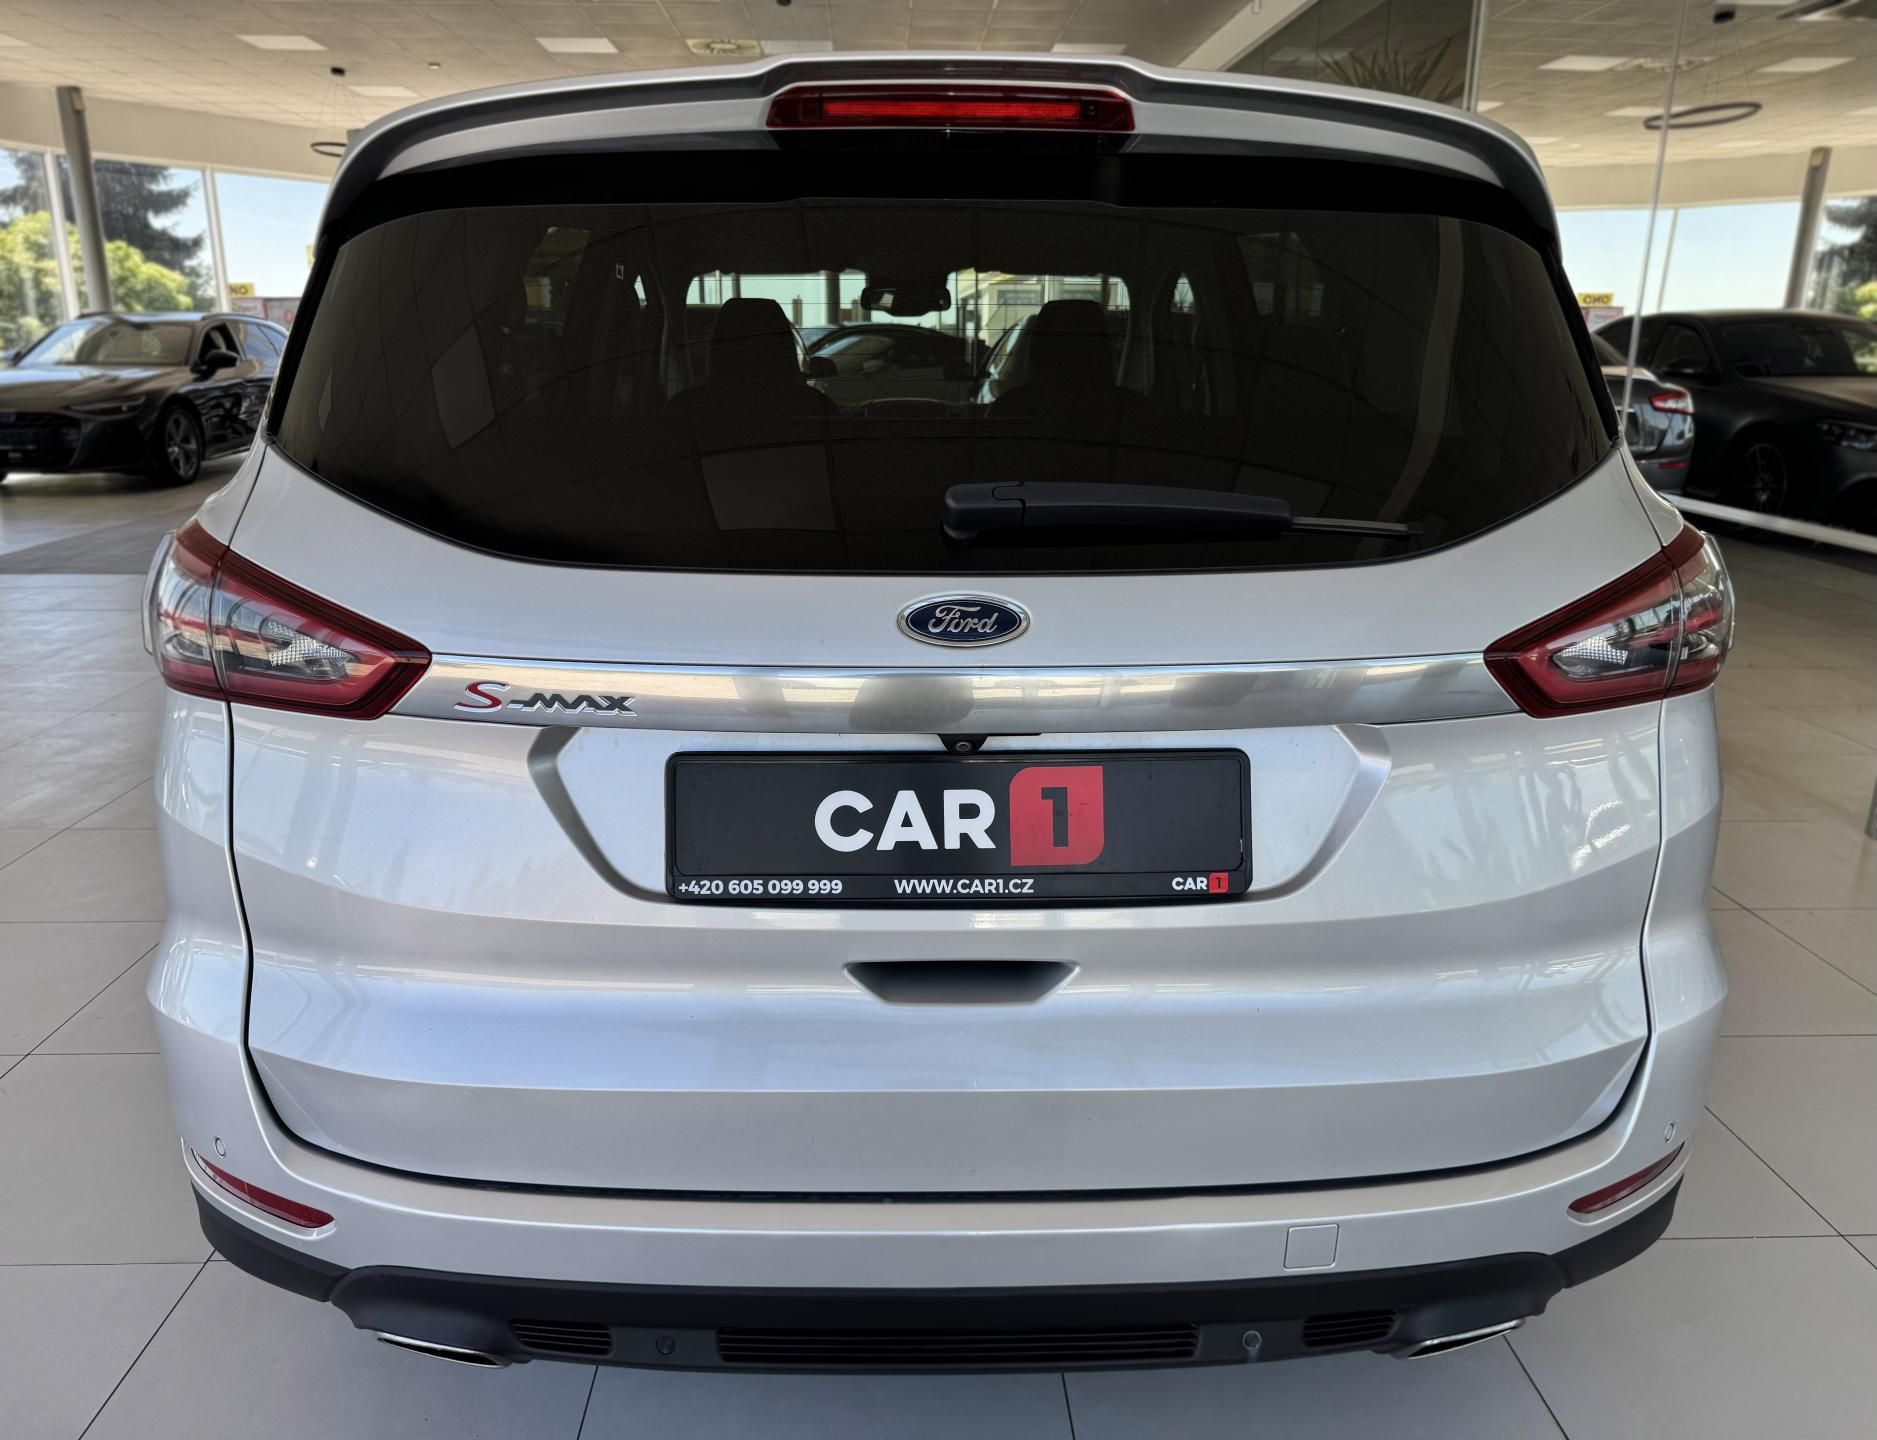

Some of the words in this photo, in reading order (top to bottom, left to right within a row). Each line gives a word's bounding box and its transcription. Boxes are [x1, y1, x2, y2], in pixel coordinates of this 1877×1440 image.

[928, 605, 998, 633] Ford
[453, 681, 637, 716] S-MAX
[678, 880, 724, 894] +420
[728, 880, 764, 894] 605
[767, 879, 804, 894] 099
[807, 879, 843, 894] 999
[893, 878, 1035, 894] WWW.CAR1.CZ
